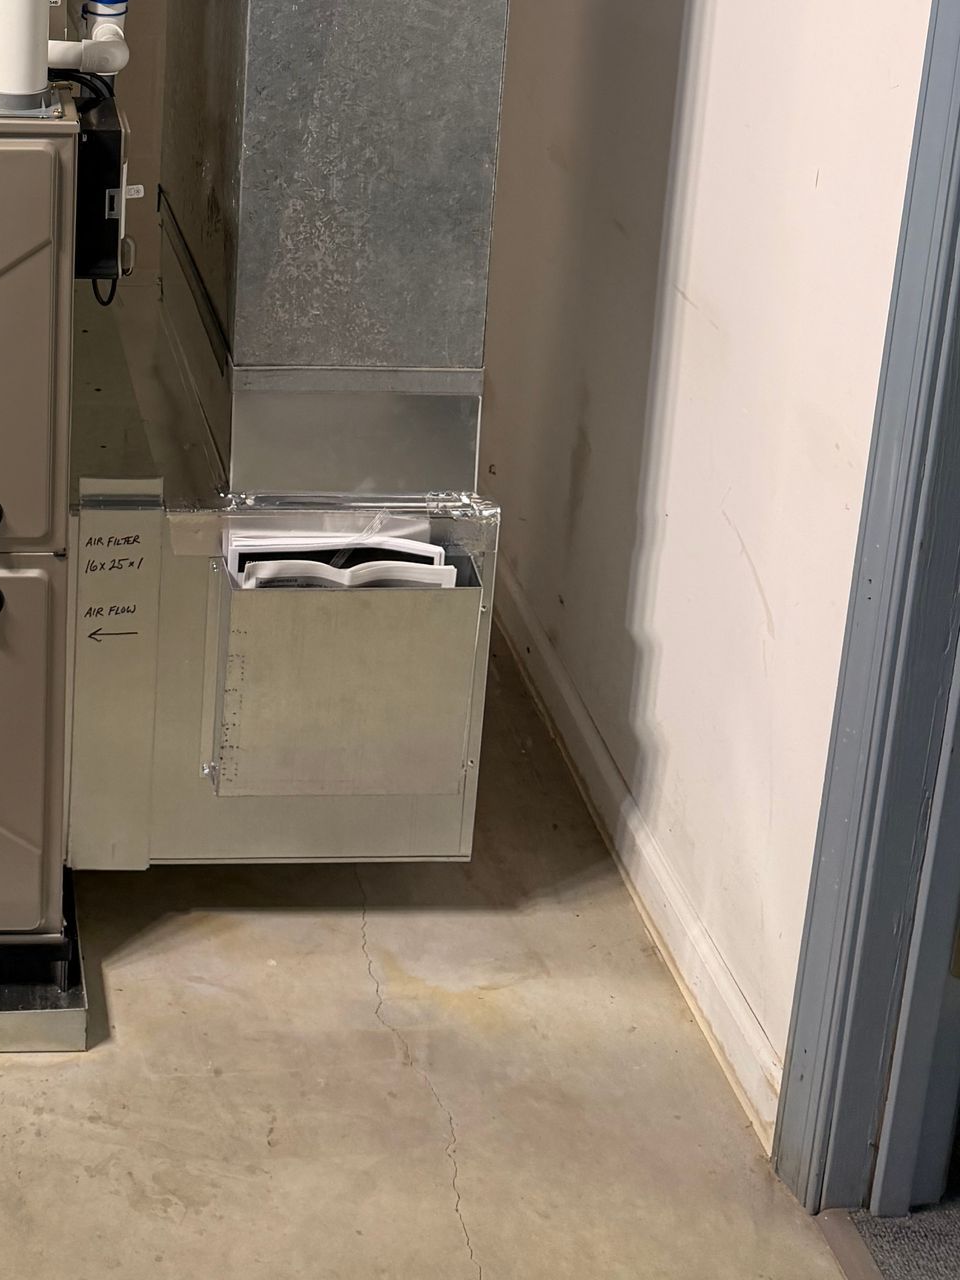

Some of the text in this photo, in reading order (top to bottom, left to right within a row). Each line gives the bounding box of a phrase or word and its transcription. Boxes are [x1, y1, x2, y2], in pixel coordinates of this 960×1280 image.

[85, 535, 141, 548] AIR FILTER
[84, 604, 137, 618] AIR FLOW
